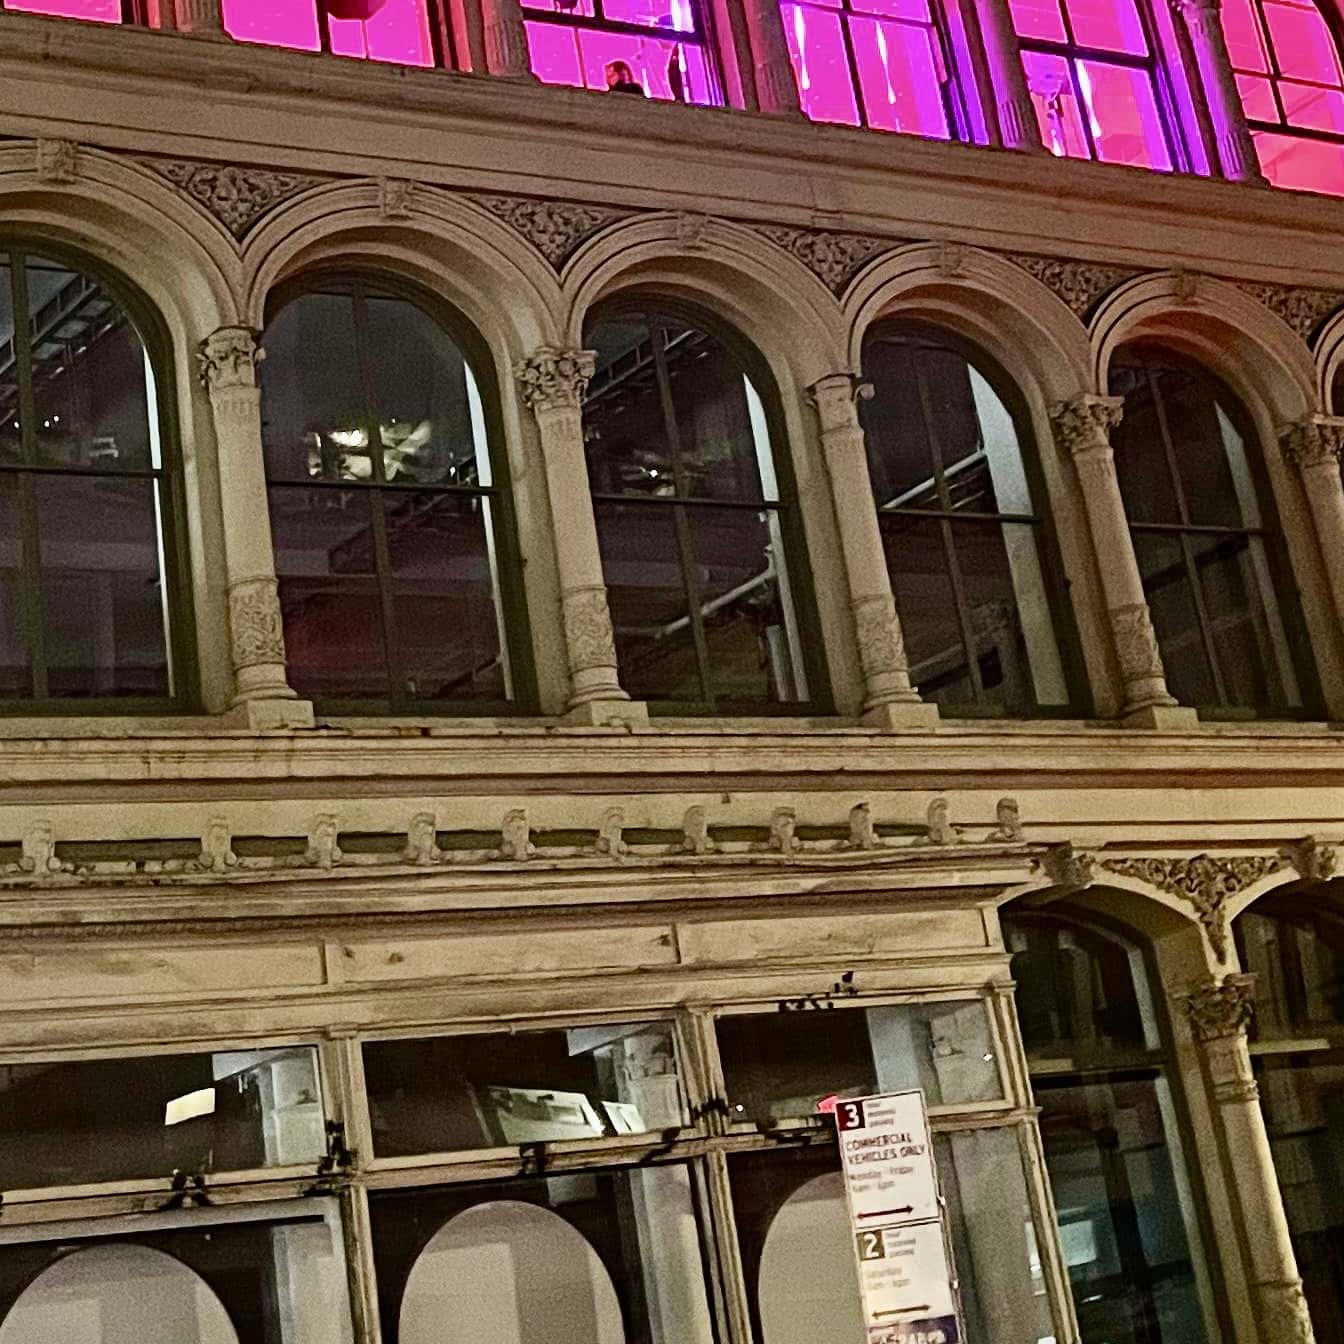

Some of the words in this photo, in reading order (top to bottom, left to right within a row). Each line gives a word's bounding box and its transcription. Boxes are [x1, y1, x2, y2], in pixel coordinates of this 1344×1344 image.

[844, 1103, 860, 1128] 3
[846, 1133, 912, 1152] COMMERCIAL
[848, 1148, 897, 1165] VEHICLES
[900, 1144, 925, 1158] ONLY
[863, 1232, 880, 1258] 2
